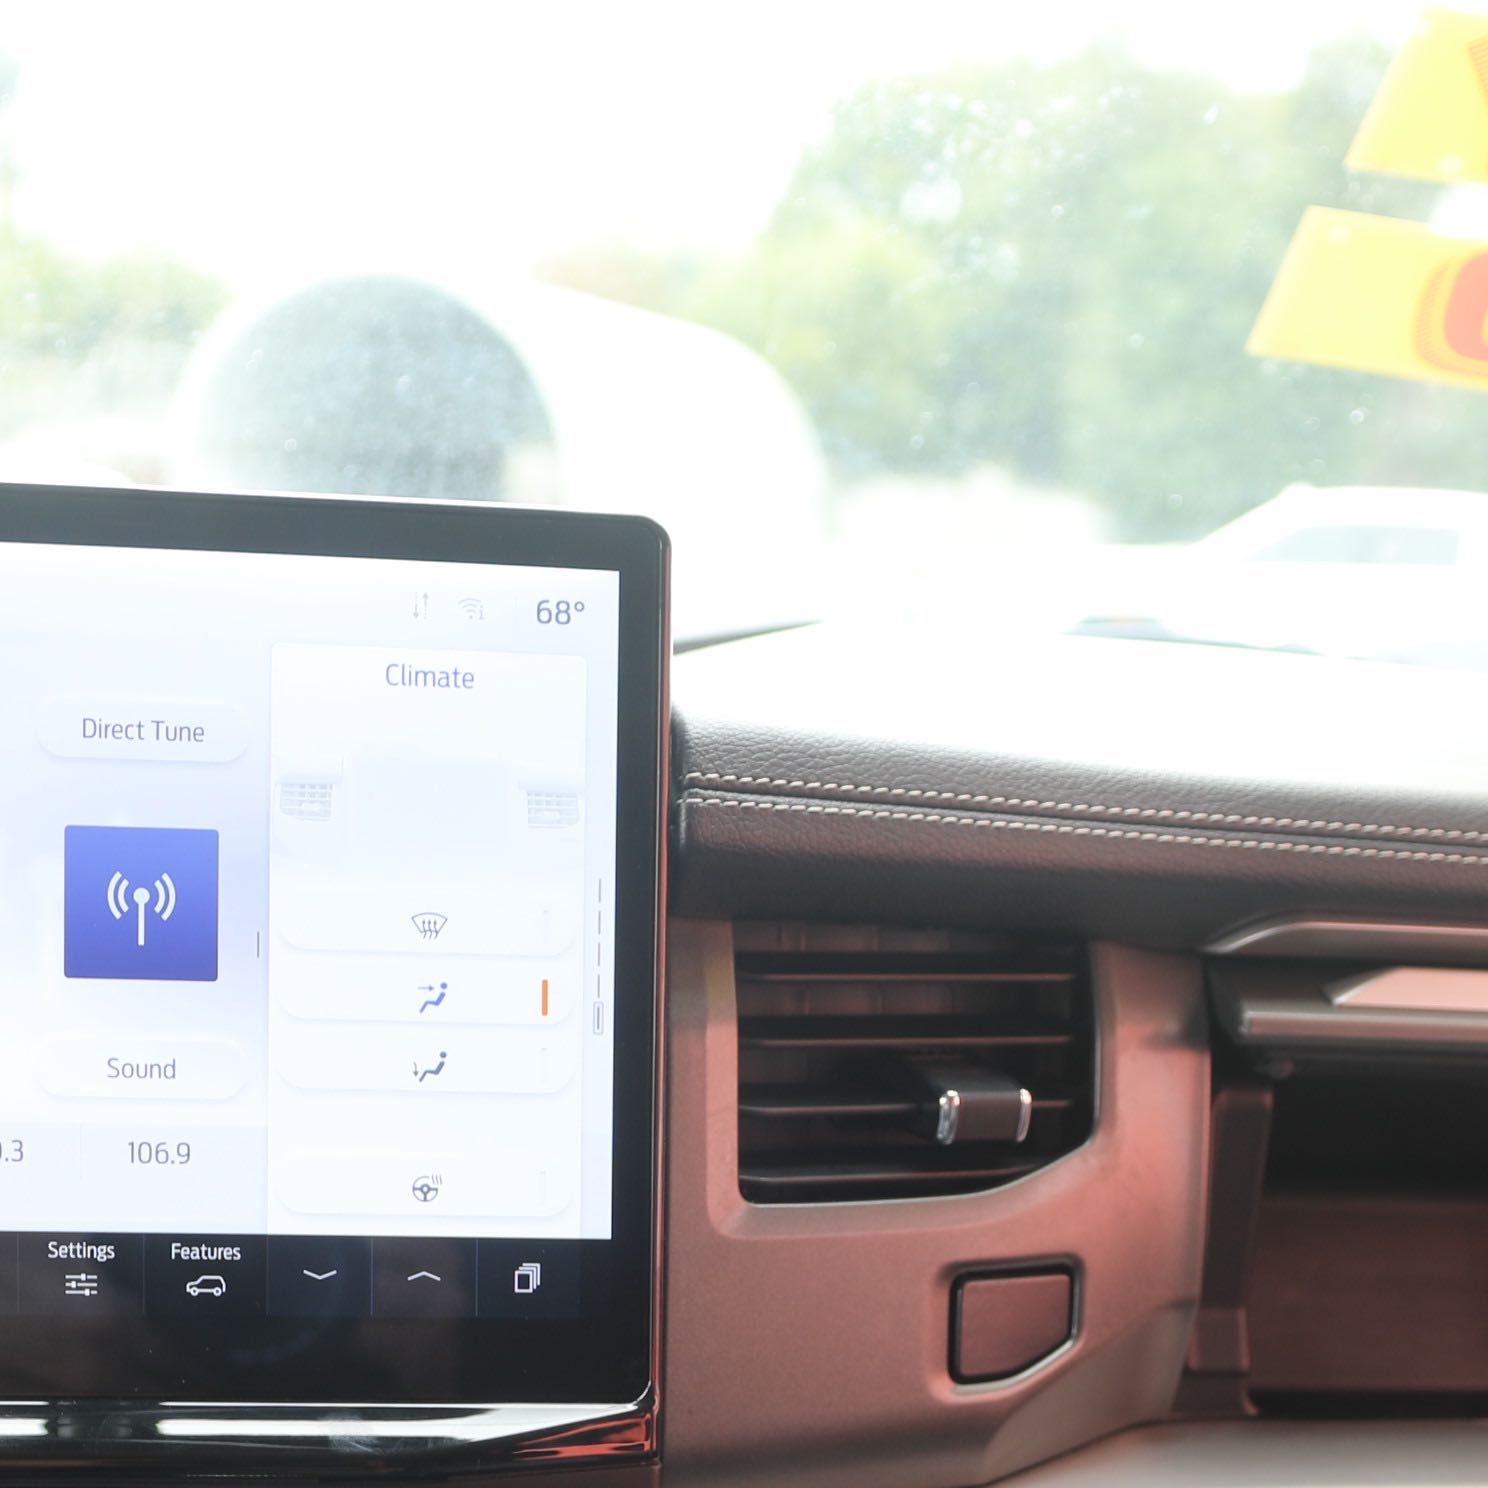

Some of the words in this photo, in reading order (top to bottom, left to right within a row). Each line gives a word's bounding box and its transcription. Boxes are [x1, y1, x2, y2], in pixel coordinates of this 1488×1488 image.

[535, 599, 586, 626] 68°
[384, 663, 475, 690] Climate
[81, 717, 145, 741] Direct
[151, 720, 205, 744] Tune
[106, 1056, 177, 1081] Sound
[126, 1140, 192, 1166] 106.9
[47, 1240, 116, 1263] Settings
[170, 1242, 242, 1262] Features
